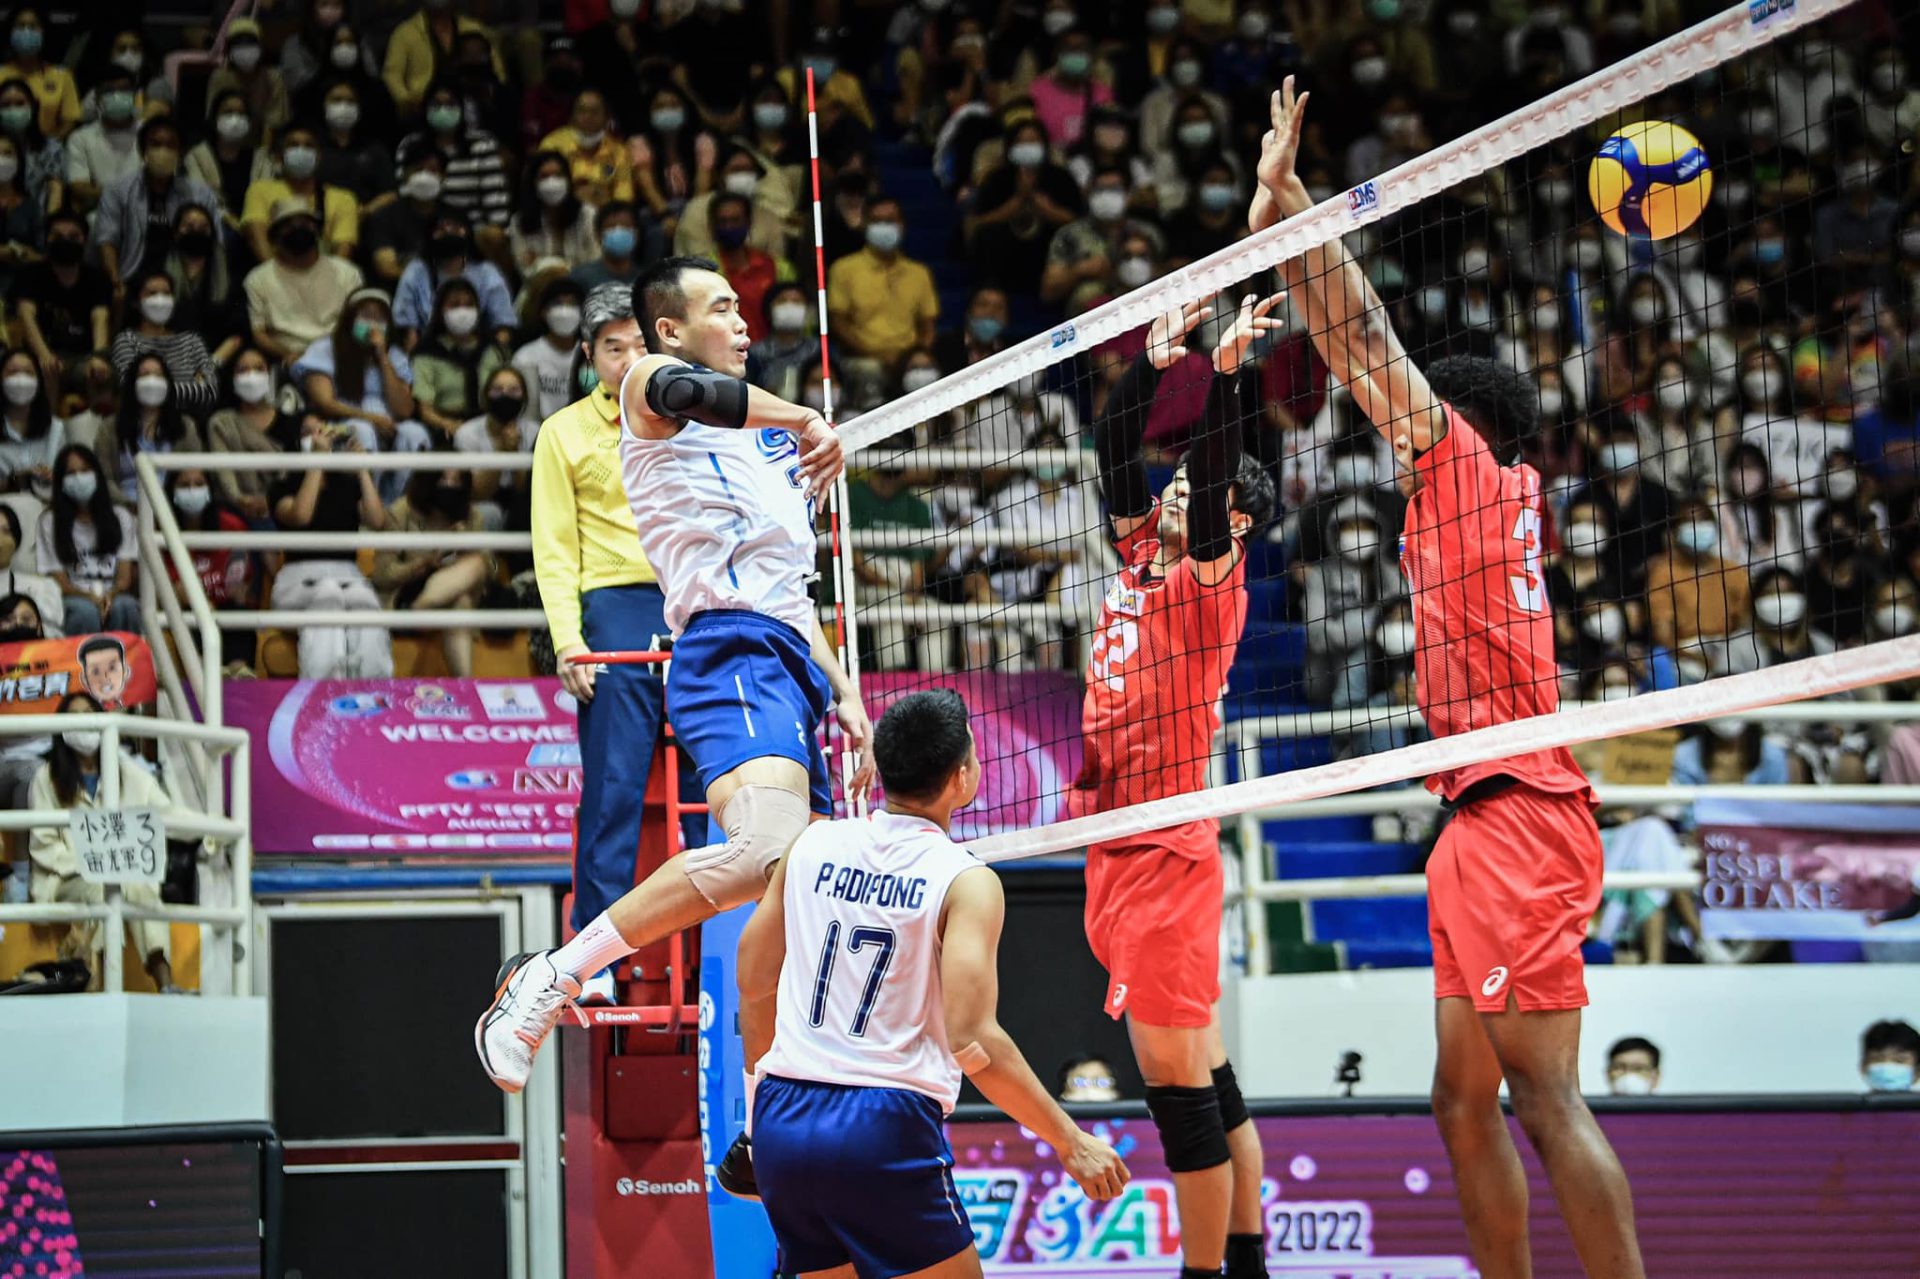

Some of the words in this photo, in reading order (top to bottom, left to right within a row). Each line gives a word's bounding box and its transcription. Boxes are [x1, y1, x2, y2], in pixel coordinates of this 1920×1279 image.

[380, 724, 576, 743] WELCOME
[1705, 852, 1793, 881] ISSEI
[1703, 878, 1843, 911] OTAKE
[808, 919, 897, 1038] 17
[604, 1012, 640, 1022] Senoh
[635, 1179, 700, 1195] Senoh
[1274, 1211, 1363, 1252] 2022
